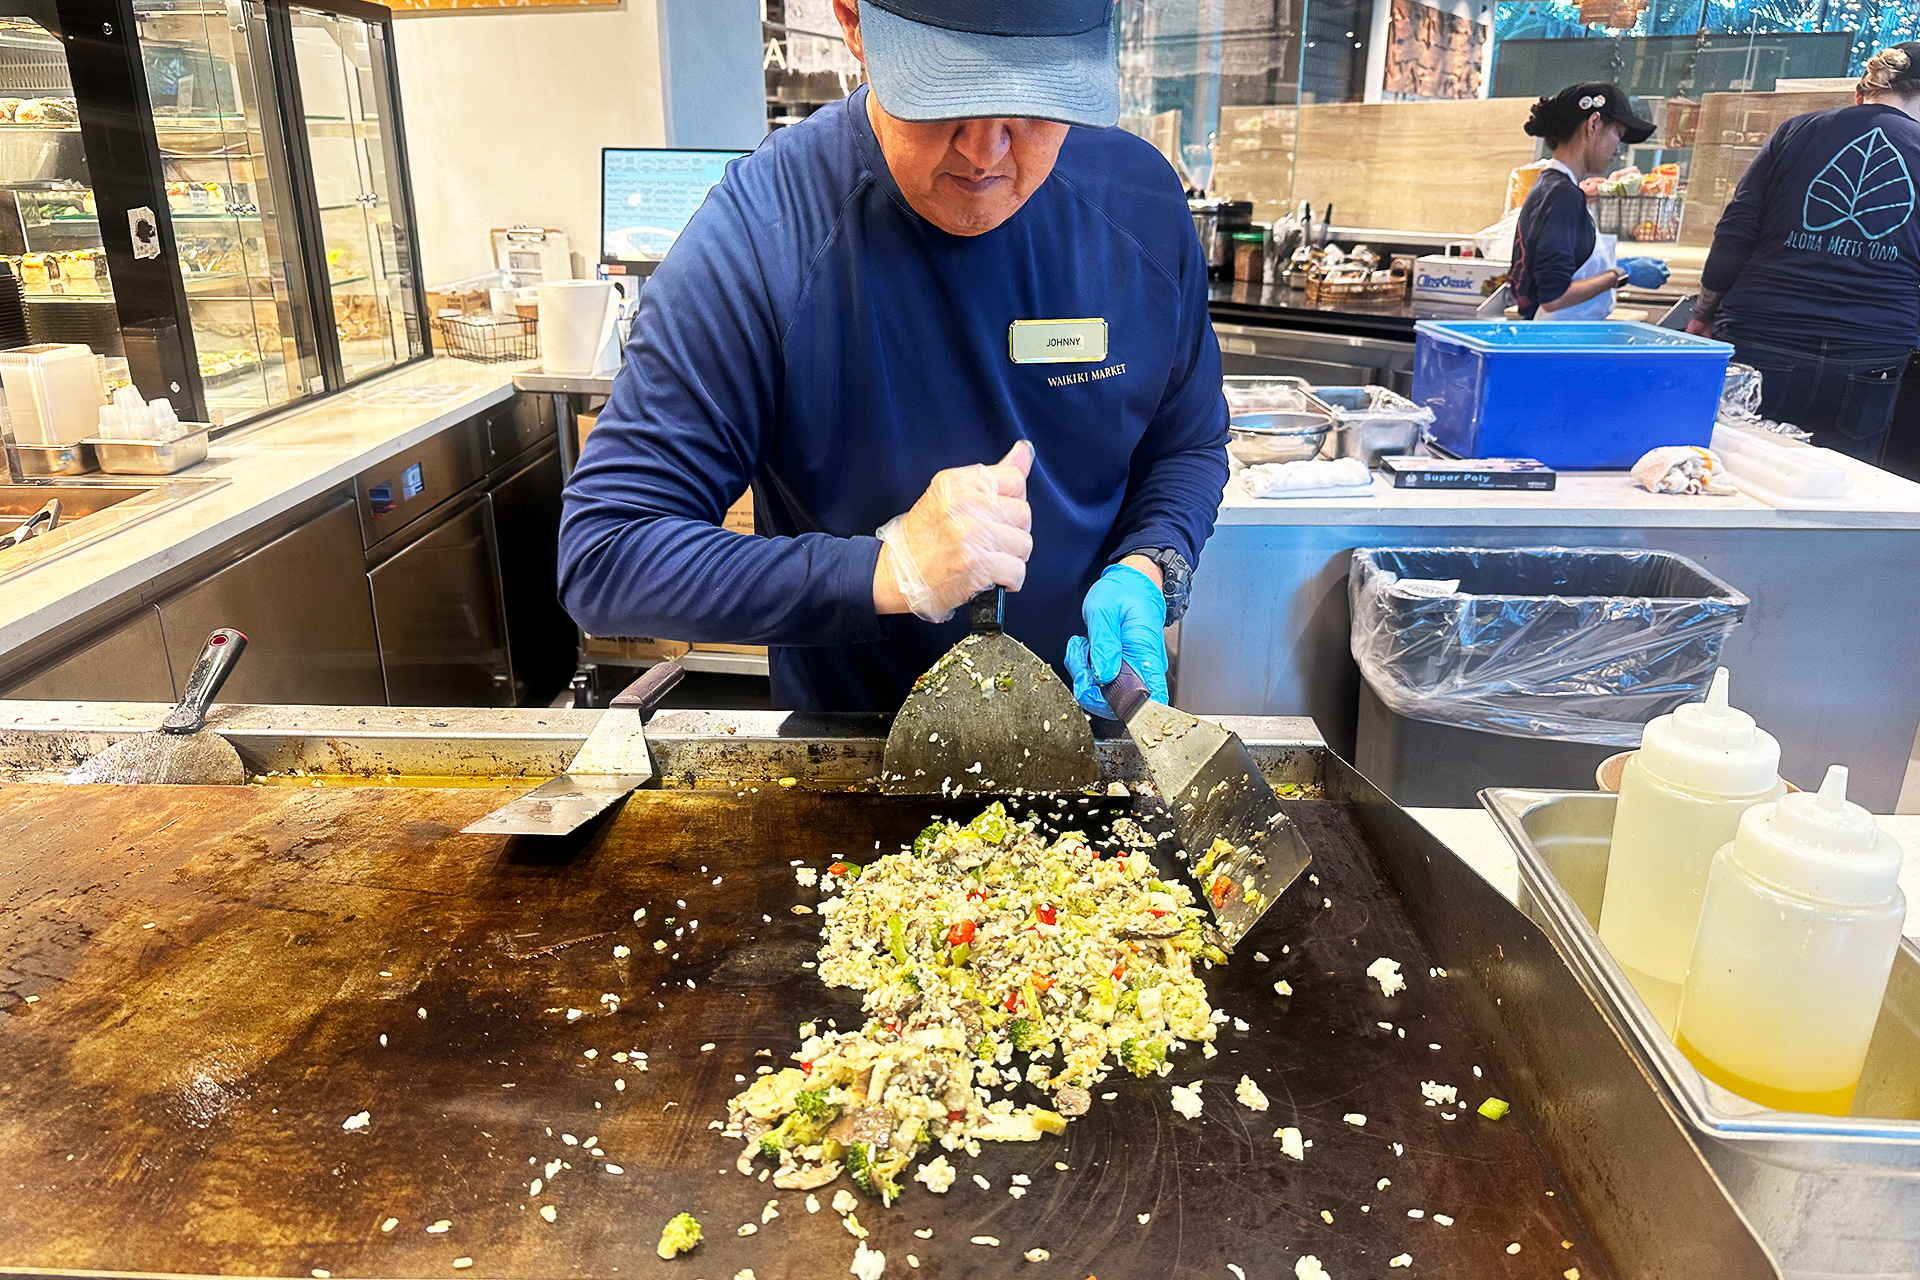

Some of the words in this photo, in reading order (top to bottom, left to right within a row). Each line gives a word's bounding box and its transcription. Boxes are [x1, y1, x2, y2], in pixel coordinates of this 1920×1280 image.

[1783, 230, 1822, 251] ALOHA
[1827, 235, 1863, 257] MEETS
[1046, 338, 1081, 347] JOHNNY
[1047, 372, 1089, 387] WAIKIKI
[1091, 364, 1126, 380] MARKET
[1423, 473, 1460, 482] Super
[1464, 473, 1490, 483] Poly
